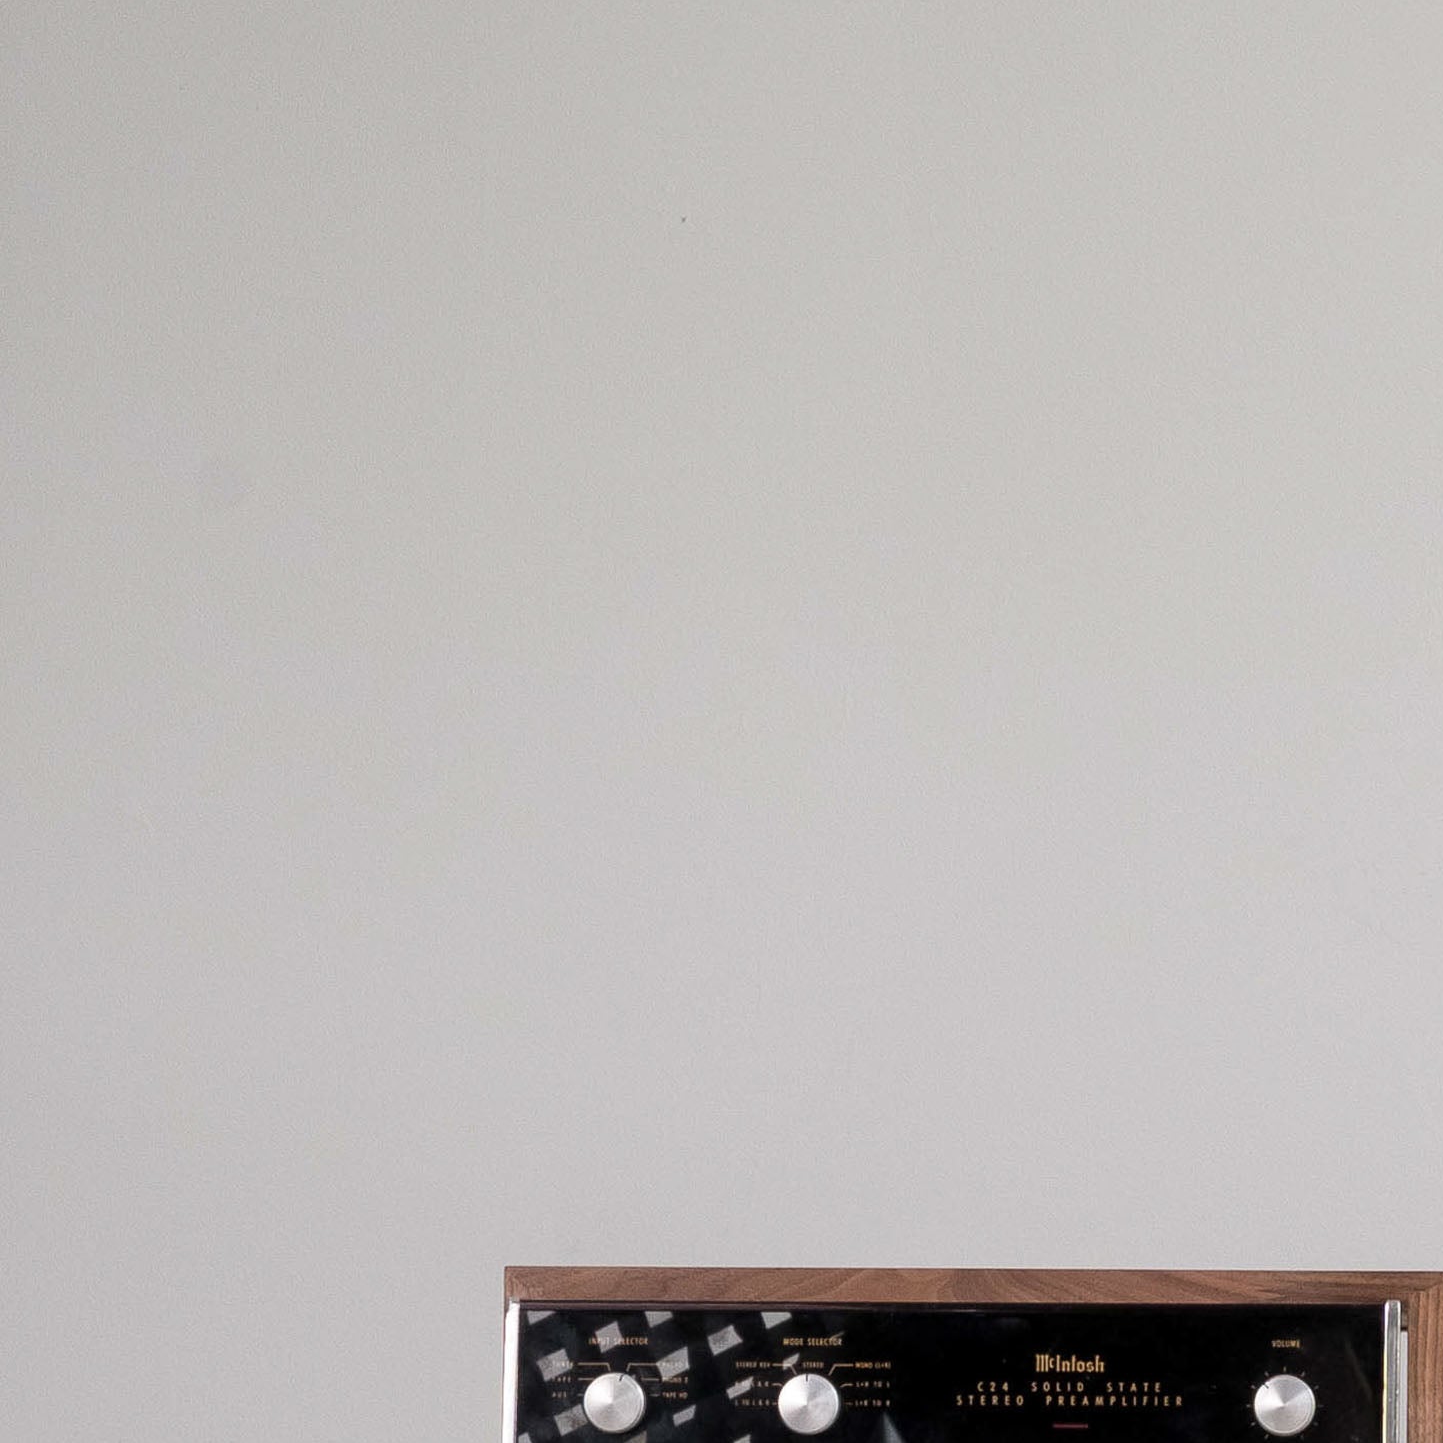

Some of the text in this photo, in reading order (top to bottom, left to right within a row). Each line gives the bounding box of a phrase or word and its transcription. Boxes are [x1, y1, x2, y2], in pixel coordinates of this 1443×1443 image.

[783, 1338, 842, 1346] MODE SELECTOR
[1271, 1339, 1301, 1348] VOLUME
[1035, 1354, 1105, 1373] McIntosh
[977, 1381, 1162, 1393] C24 SOLID STATE
[956, 1394, 1183, 1406] STEREO PREAMPLIFIER
